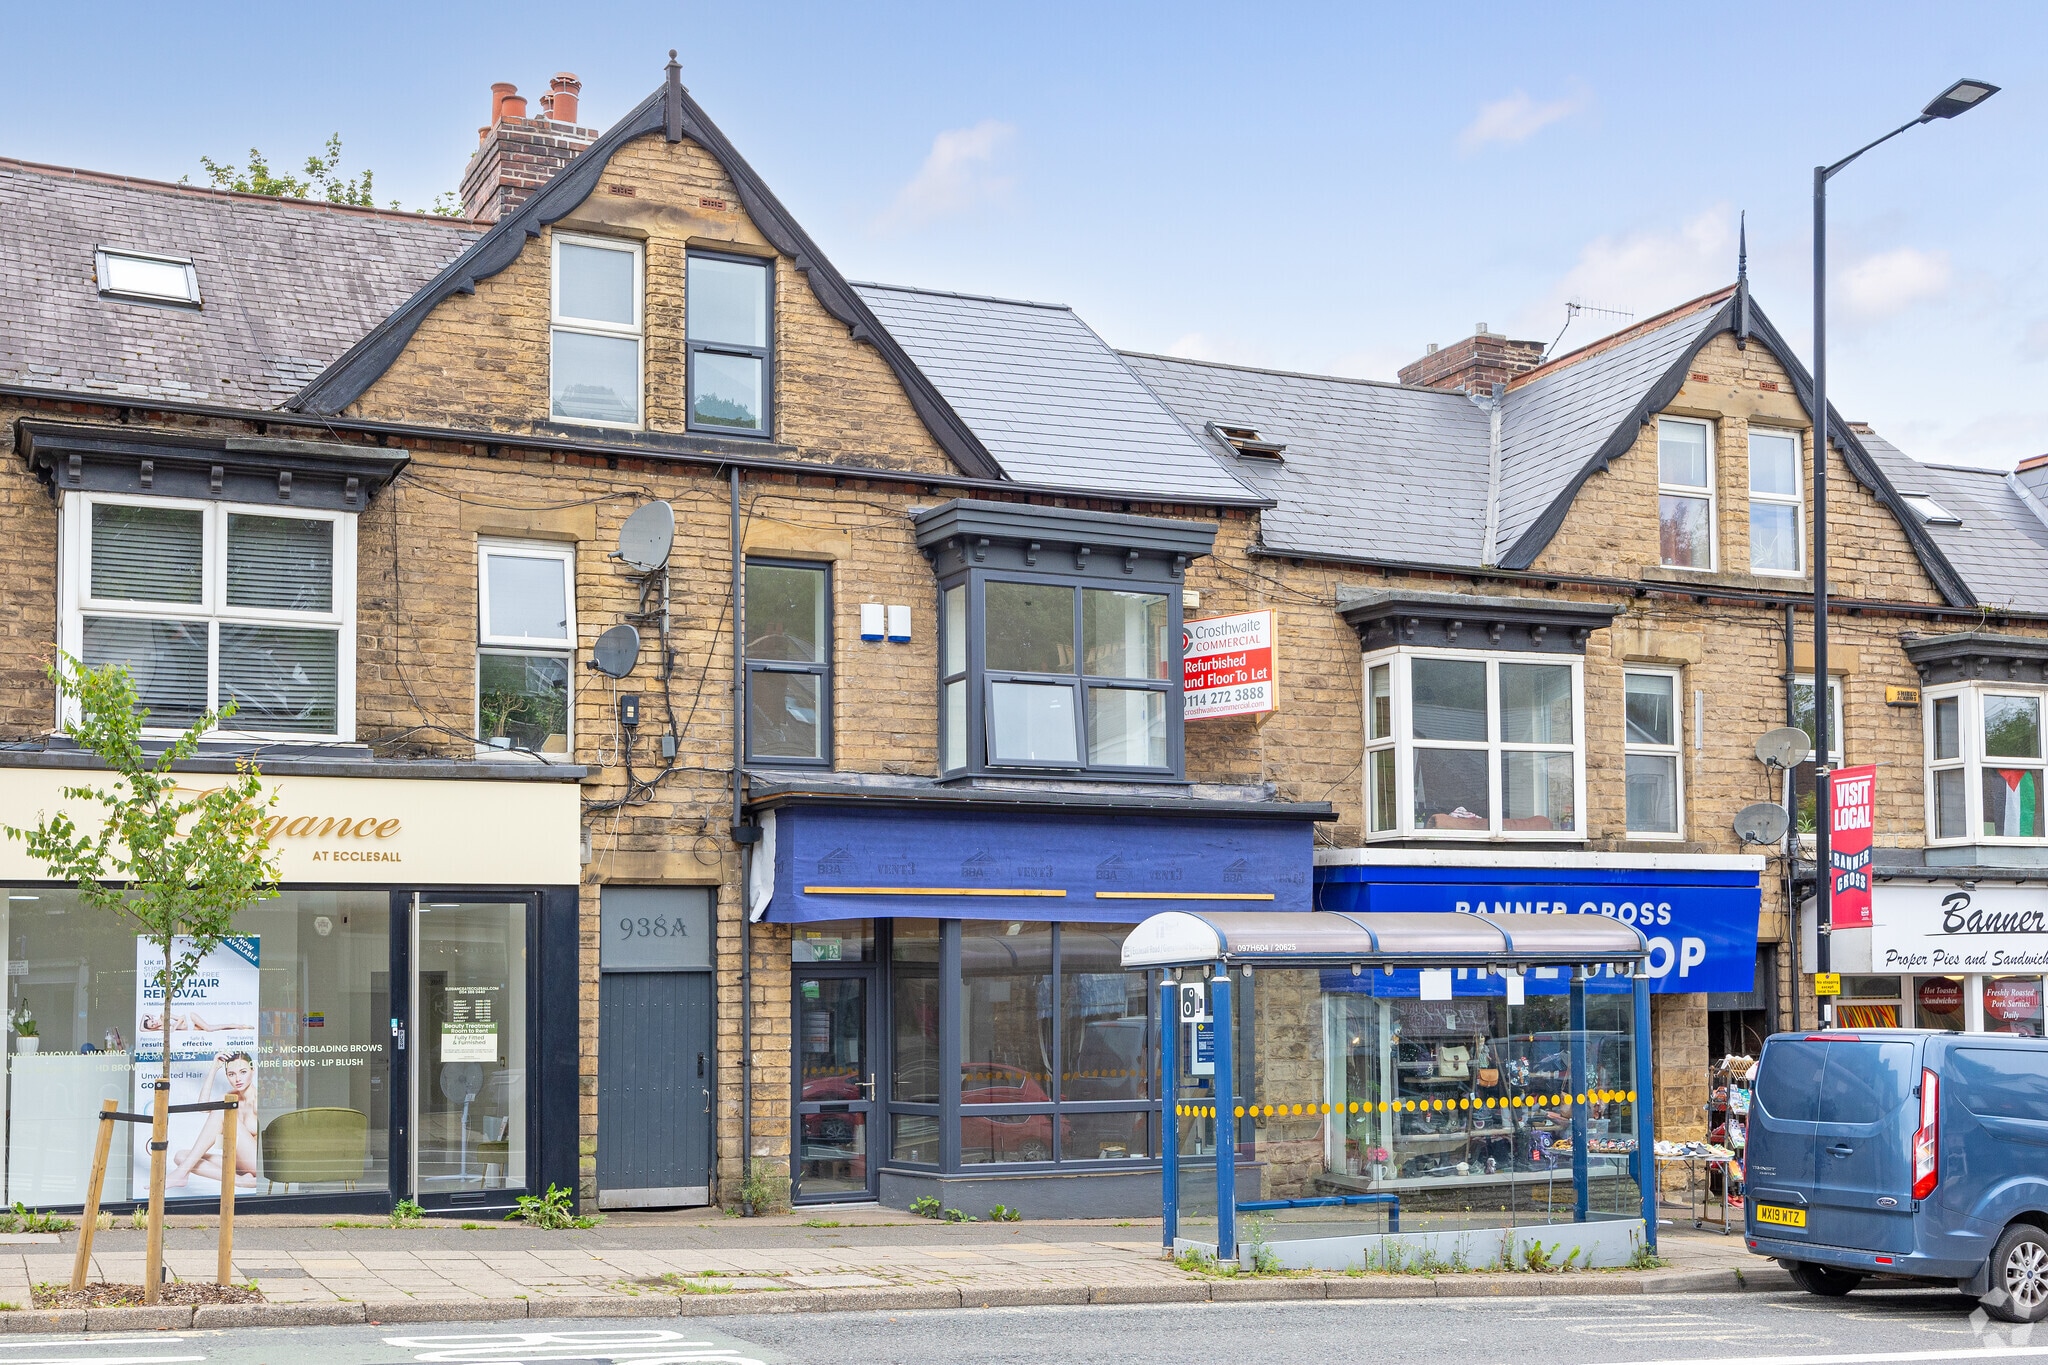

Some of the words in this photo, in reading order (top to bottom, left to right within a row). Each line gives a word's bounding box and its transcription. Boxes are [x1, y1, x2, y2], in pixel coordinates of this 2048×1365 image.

[1196, 619, 1260, 639] Crosthwaite
[1196, 634, 1260, 652] COMMERCIAL
[1185, 653, 1246, 674] Refurbished
[1184, 675, 1204, 688] und
[1208, 672, 1234, 686] Floor
[1236, 670, 1248, 682] To
[1252, 667, 1268, 680] Let
[1210, 690, 1231, 704] 272
[1235, 686, 1264, 702] 3888
[1836, 780, 1870, 808] VISIT
[1834, 805, 1871, 832] LOCAL
[312, 851, 328, 862] AT
[333, 851, 402, 863] ECCLESALL
[1834, 849, 1870, 871] BANNER
[1837, 872, 1866, 892] CROSS
[1941, 892, 2046, 934] Banner
[620, 914, 688, 940] 938A
[226, 938, 258, 962] AVAILABLE
[238, 938, 254, 950] NOW
[1886, 949, 1928, 969] Proper
[1933, 949, 1960, 966] Pies
[1965, 951, 1988, 966] and
[188, 979, 219, 988] HAIR
[1987, 989, 2009, 997] Freshly
[2003, 1012, 2019, 1020] Daily
[280, 1045, 349, 1054] MICROBLADING
[250, 1058, 280, 1068] OMBRÉ
[1761, 1207, 1780, 1221] MX19
[1782, 1209, 1800, 1223] WTZ
